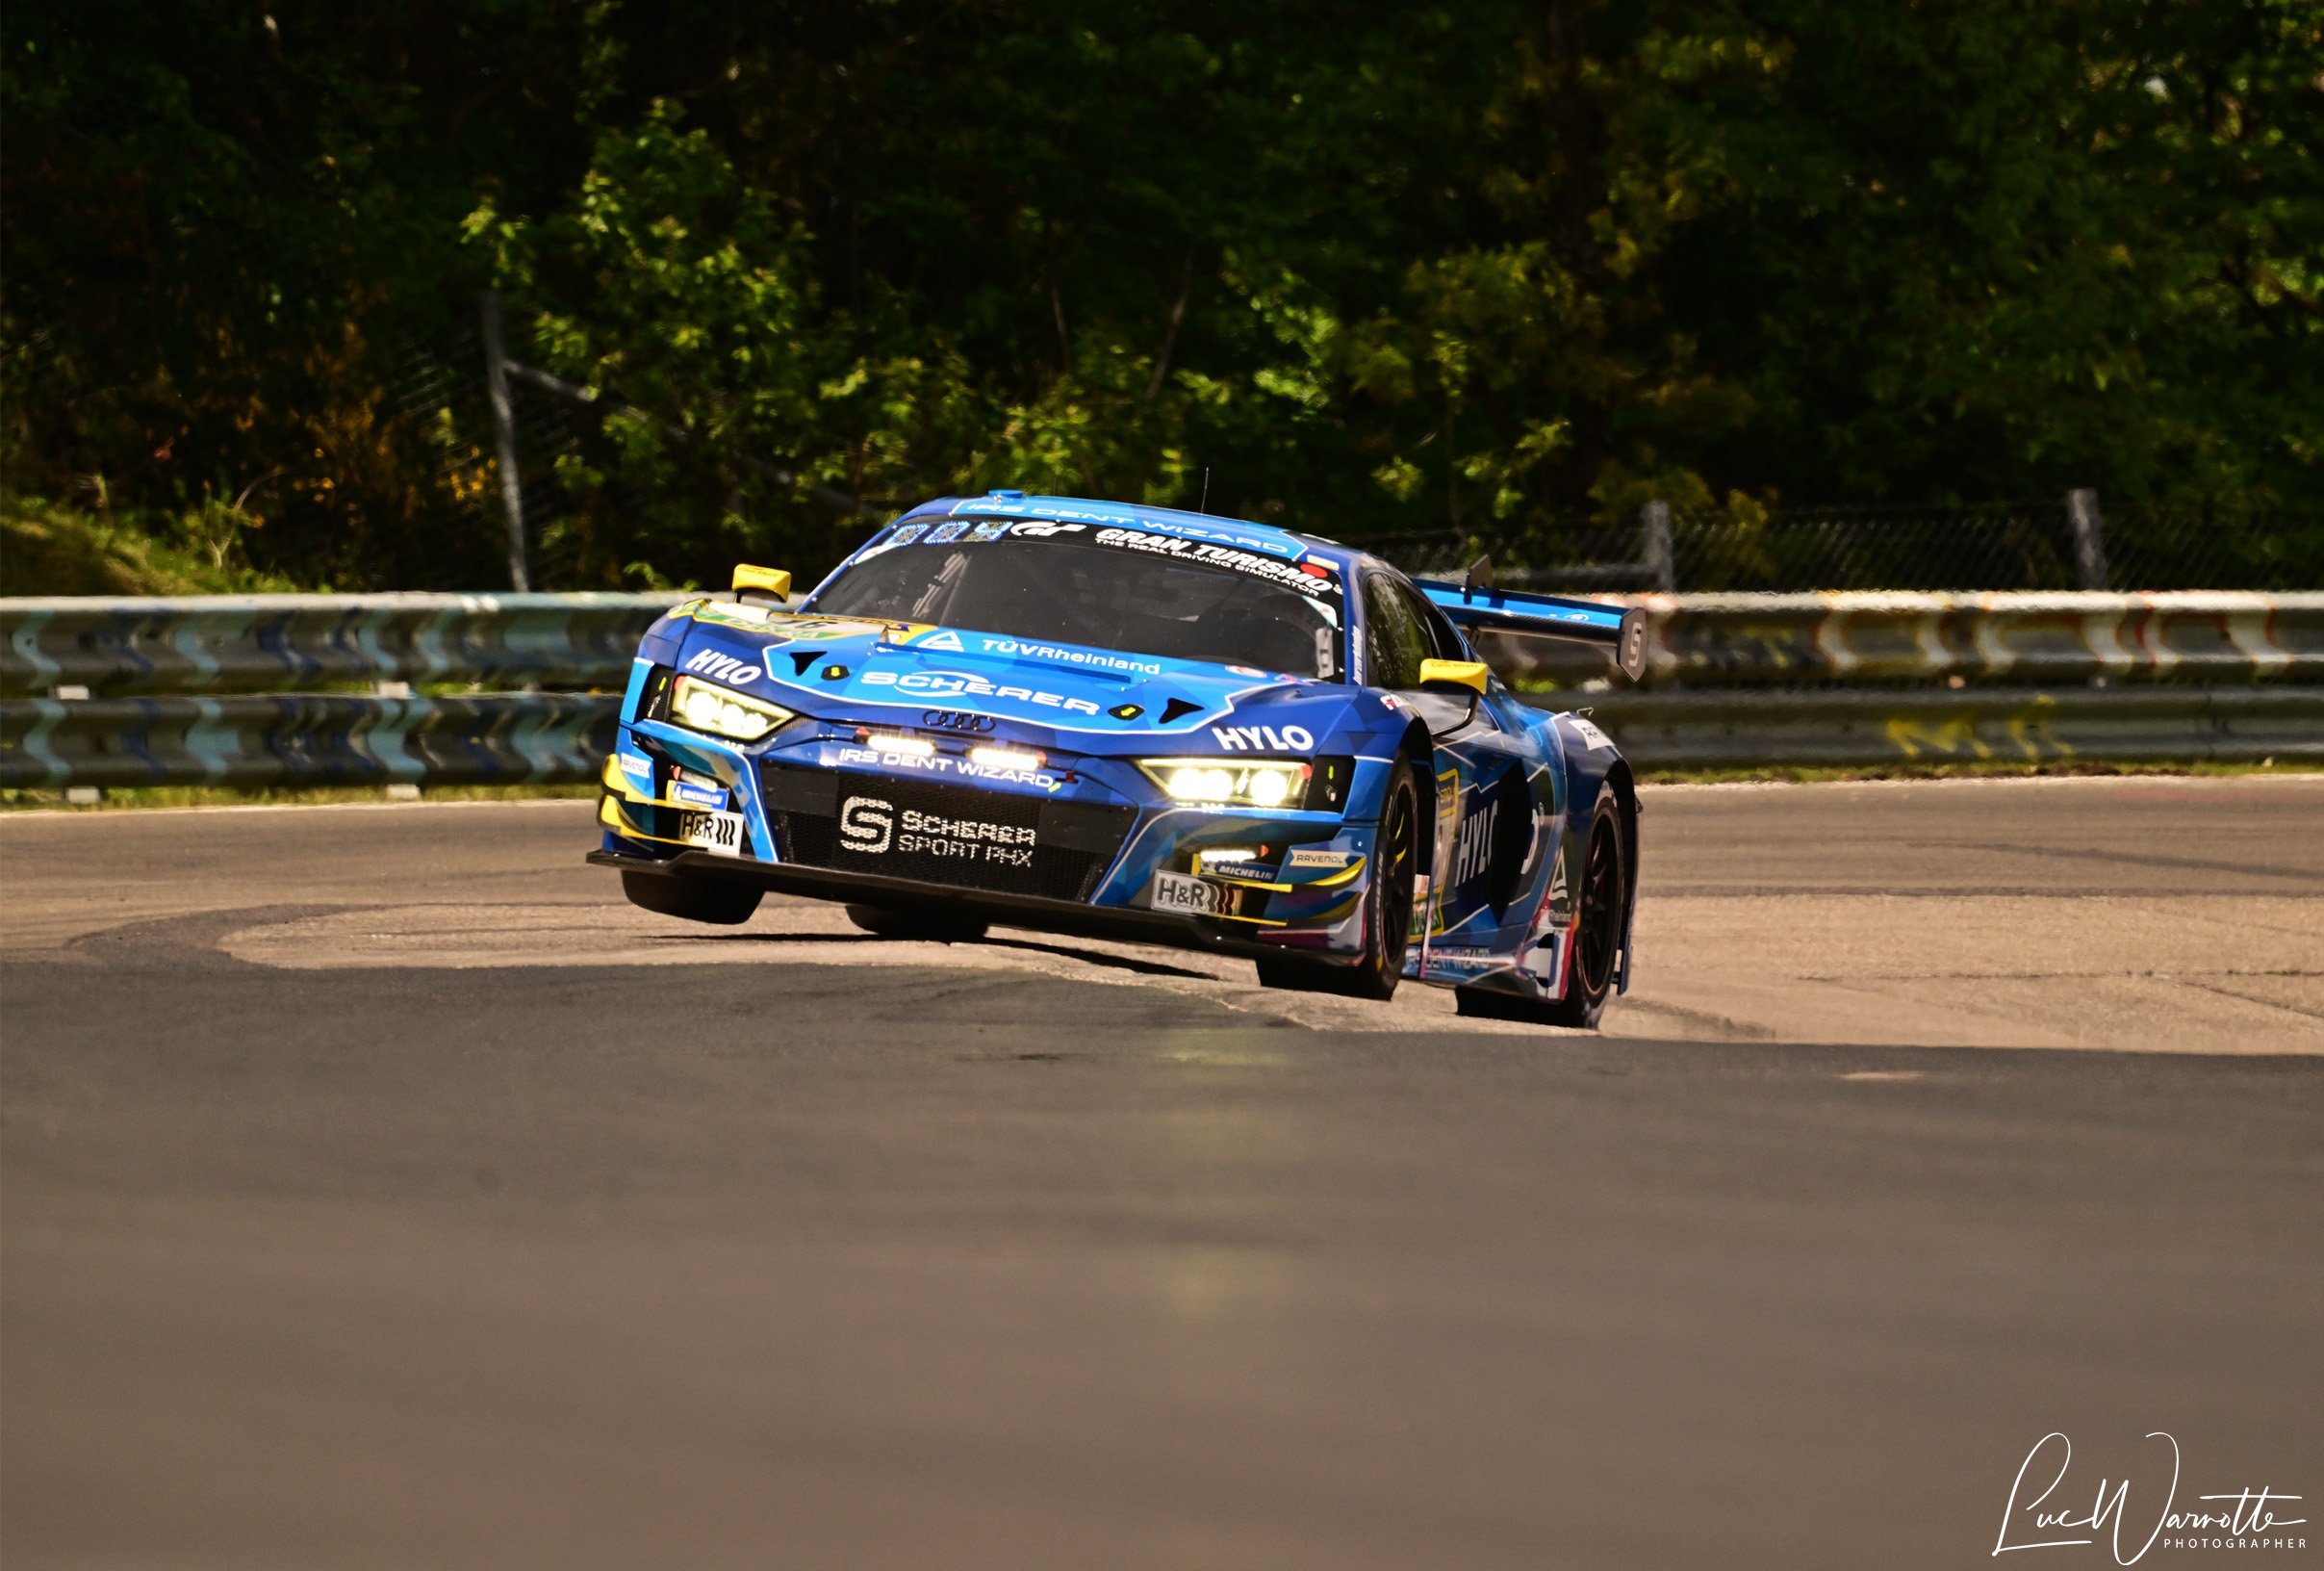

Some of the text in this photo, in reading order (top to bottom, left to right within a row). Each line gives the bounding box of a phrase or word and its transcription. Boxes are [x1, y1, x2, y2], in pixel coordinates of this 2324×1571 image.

[966, 502, 1289, 554] IRS DENT WIZARD
[1095, 528, 1334, 592] GRAN TURISMO
[1095, 537, 1126, 547] THE
[1128, 542, 1168, 555] REAL
[1170, 548, 1233, 569] DRIVING
[1235, 561, 1320, 597] SIMULATOR
[684, 648, 762, 685] HYLO
[981, 637, 1161, 676] TÜVRheinland
[859, 671, 1101, 716] SCHERER
[1212, 725, 1315, 751] HYLO
[838, 748, 1055, 787] IRS DENT WIZARD
[901, 810, 1036, 846] SCHERER
[898, 834, 1034, 867] SPORT PHX
[1296, 854, 1343, 864] RAVENOL
[1217, 865, 1275, 880] MICHELIN
[1157, 877, 1205, 907] H&R
